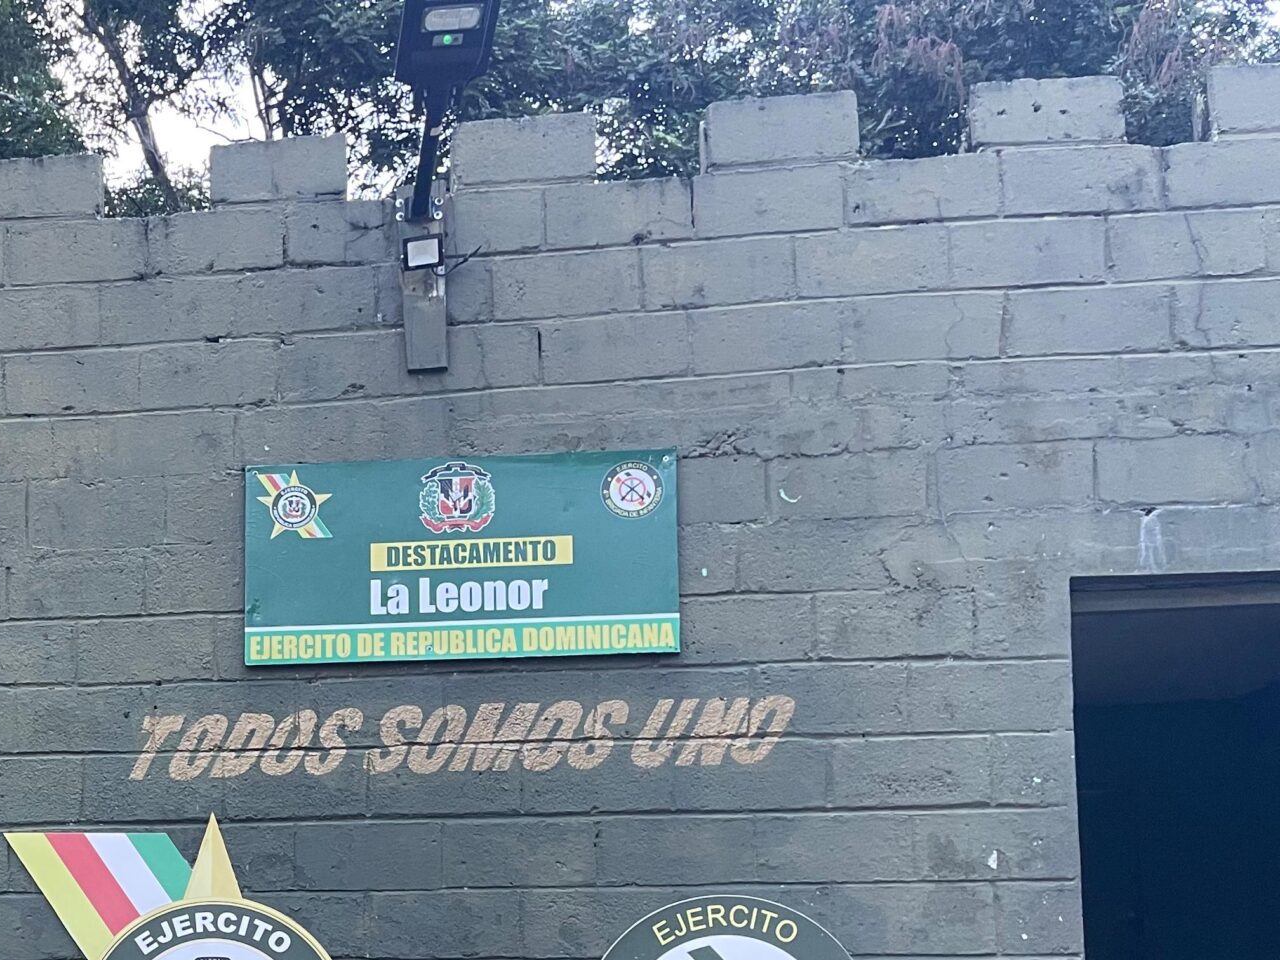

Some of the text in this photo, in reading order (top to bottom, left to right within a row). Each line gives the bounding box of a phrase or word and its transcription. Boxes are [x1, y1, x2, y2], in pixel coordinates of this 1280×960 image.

[386, 540, 556, 567] DESTACAMENTO
[370, 577, 549, 616] La Leonor
[250, 622, 675, 660] EJERCITO DE REPUBLICA DOMINICANA
[128, 694, 796, 781] TODOS SOMOS UNO
[134, 911, 291, 956] EJERCITO
[652, 904, 798, 946] EJERCITO
